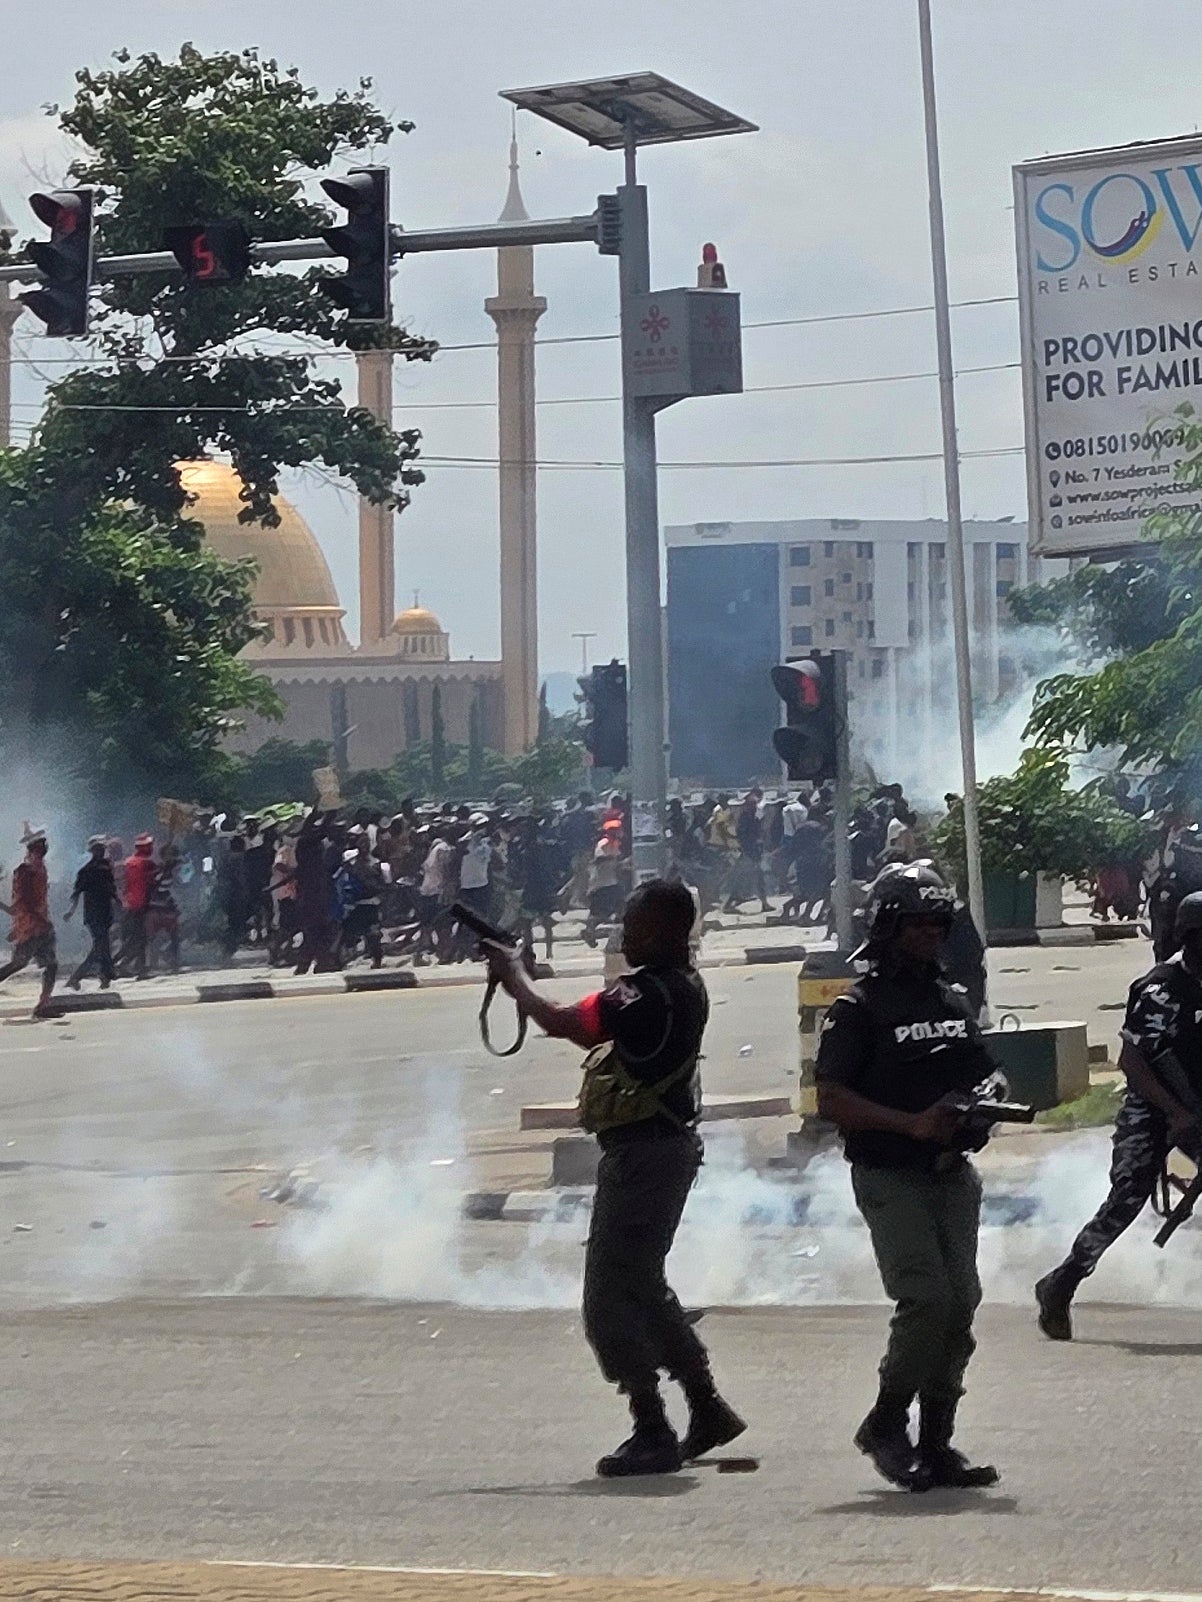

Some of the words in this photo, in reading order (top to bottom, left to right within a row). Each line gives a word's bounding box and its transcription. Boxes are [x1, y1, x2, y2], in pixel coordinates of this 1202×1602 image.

[1038, 273, 1108, 295] REAL
[1045, 369, 1106, 402] FOR
[1064, 470, 1089, 485] No.
[1092, 467, 1100, 482] 7
[894, 1019, 968, 1043] POLICE
